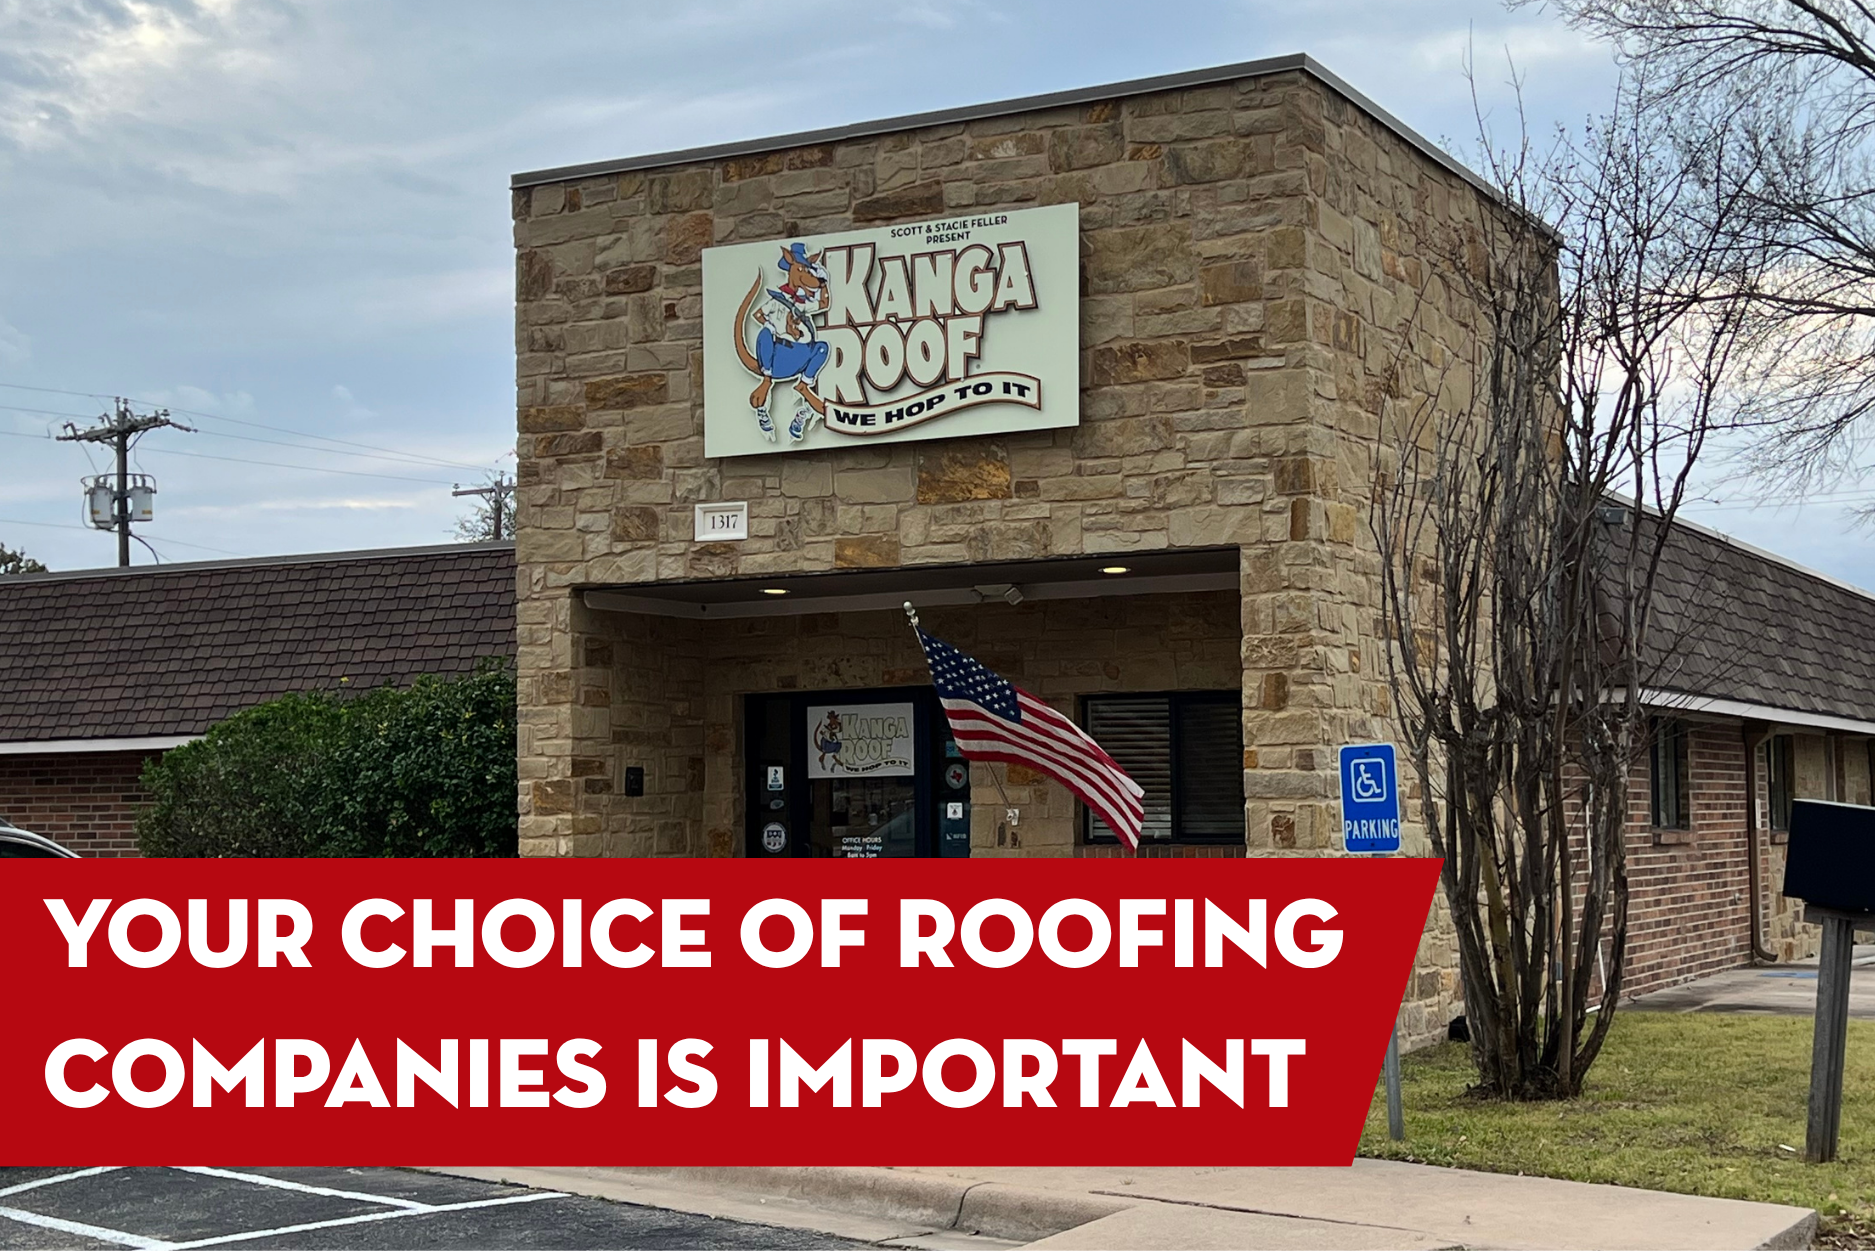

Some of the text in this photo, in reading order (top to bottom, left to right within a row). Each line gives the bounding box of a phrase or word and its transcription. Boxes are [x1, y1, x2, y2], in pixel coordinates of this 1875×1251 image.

[891, 215, 1008, 238] SCOTT & STACIE FELLER
[926, 231, 971, 245] PRESENT
[823, 240, 1038, 326] KANGA
[816, 314, 983, 406] ROOF
[833, 381, 1031, 426] WE HOP TO IT
[711, 514, 739, 530] 1317
[841, 713, 909, 739] KANGA
[839, 738, 893, 765] ROOF
[862, 763, 882, 772] HOP
[1345, 818, 1398, 839] PARKING
[866, 844, 883, 852] Friday
